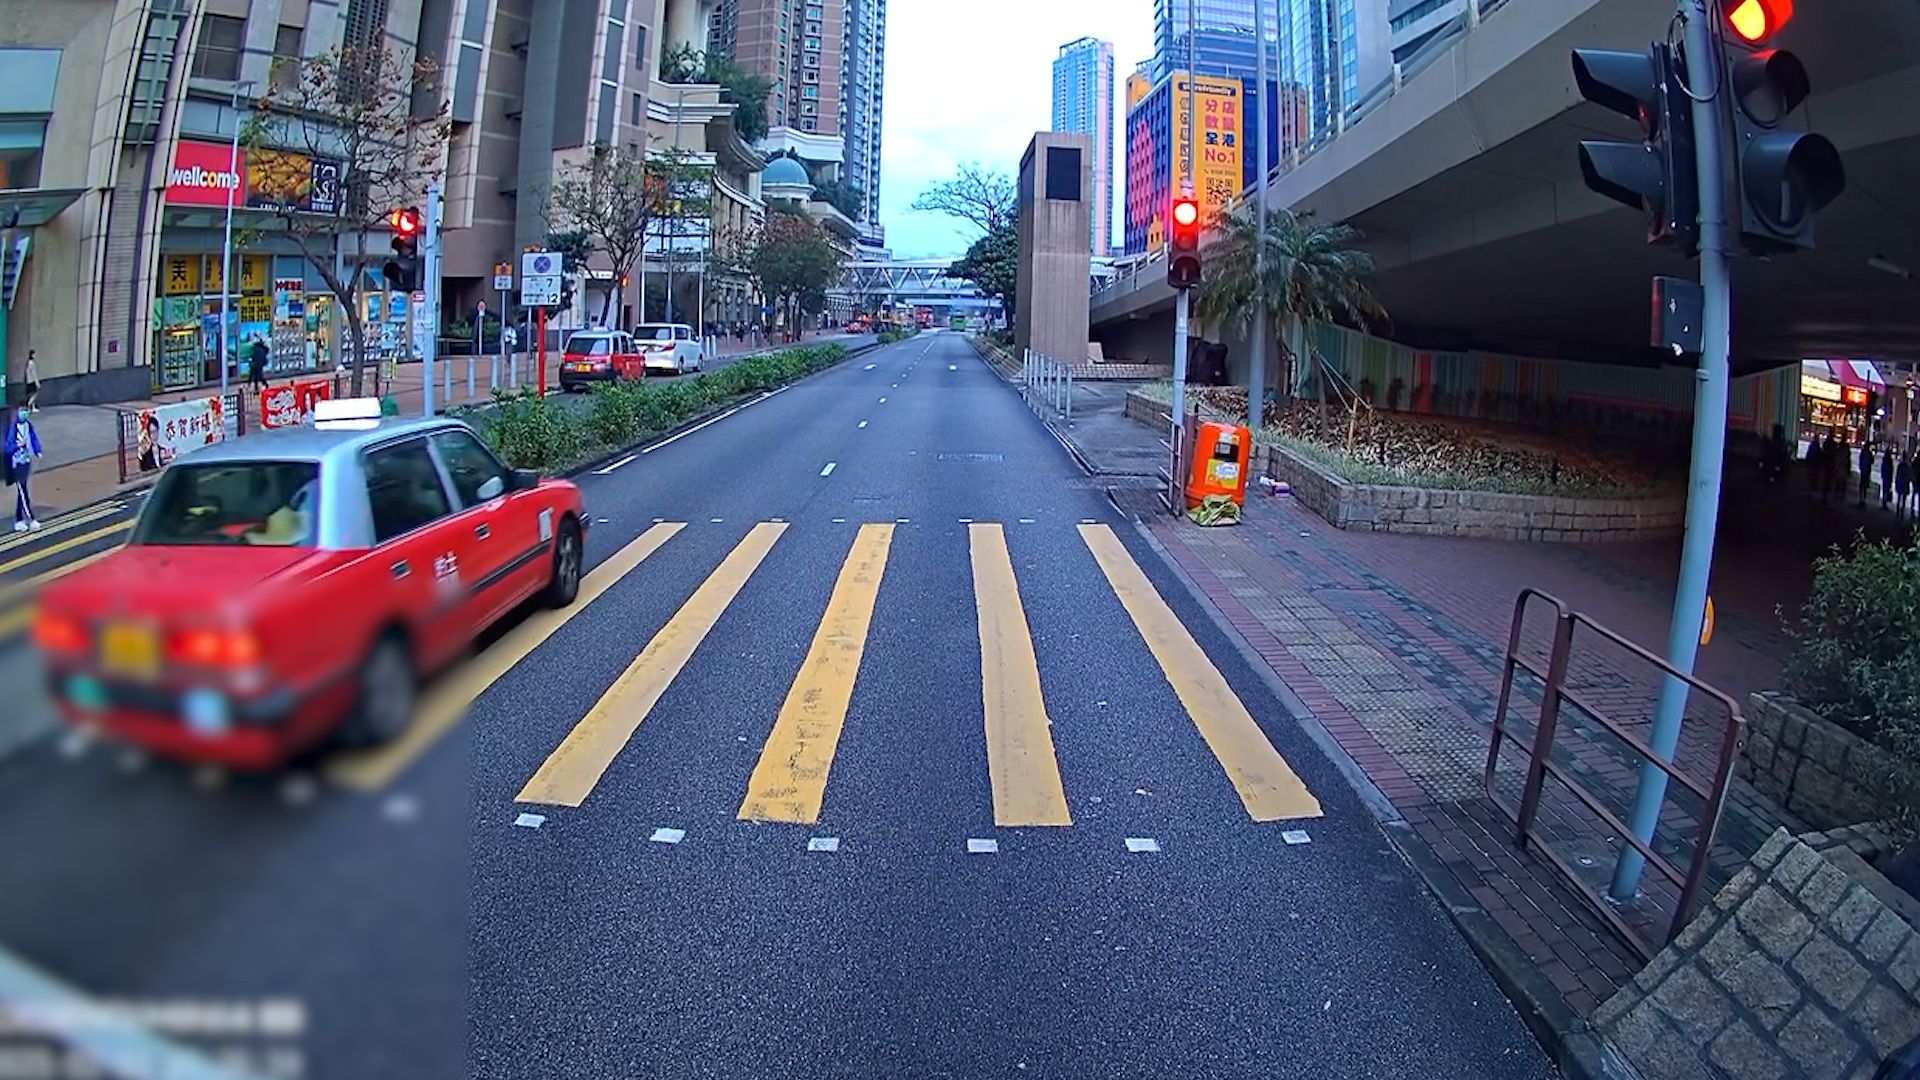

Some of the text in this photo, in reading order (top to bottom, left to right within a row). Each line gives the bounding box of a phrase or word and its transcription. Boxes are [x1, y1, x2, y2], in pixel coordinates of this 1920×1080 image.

[1205, 99, 1235, 114] 分店
[1206, 132, 1235, 147] 全港
[1205, 148, 1236, 165] No.1
[172, 166, 239, 188] wellcome
[547, 278, 553, 288] 7
[547, 293, 558, 304] 12
